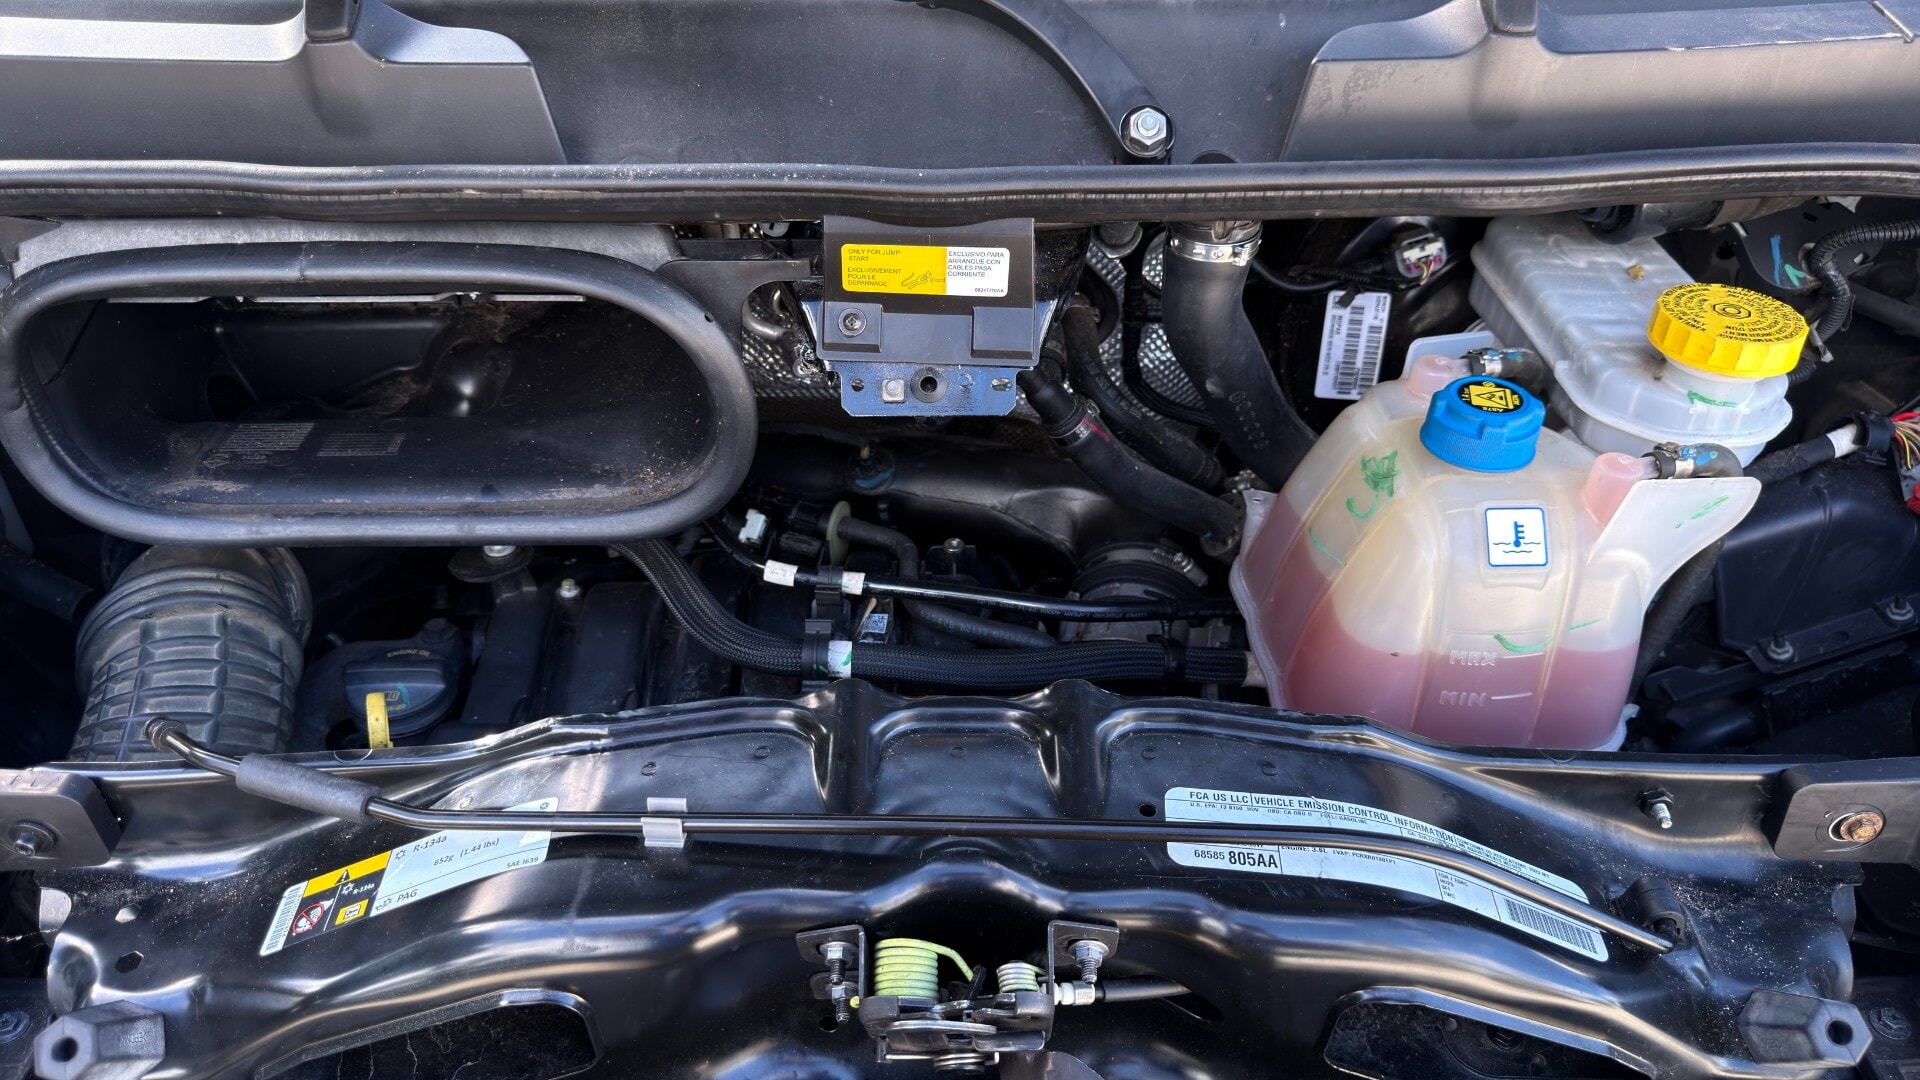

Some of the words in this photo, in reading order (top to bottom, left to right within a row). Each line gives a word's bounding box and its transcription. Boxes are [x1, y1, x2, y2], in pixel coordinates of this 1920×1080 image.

[948, 250, 986, 258] EXCLUSIVO
[947, 270, 986, 278] CORRIENTE
[387, 649, 418, 657] ENGINE
[1448, 649, 1498, 667] MAX
[1439, 690, 1487, 707] MIN
[1189, 791, 1209, 801] FCA
[1213, 792, 1227, 802] US
[1230, 794, 1249, 804] LLC
[1254, 796, 1295, 808] VEHICLE
[1298, 799, 1345, 814] EMISSION
[1348, 806, 1393, 823] CONTROL
[1394, 816, 1455, 845] INFORMATION
[412, 834, 447, 853] R-134a
[433, 855, 454, 867] 652g
[459, 843, 481, 859] (1.44
[482, 837, 500, 851] lbs)
[505, 859, 521, 869] SAE
[1194, 849, 1226, 860] 68585
[1228, 850, 1279, 869] 805AA
[396, 888, 419, 903] PAG
